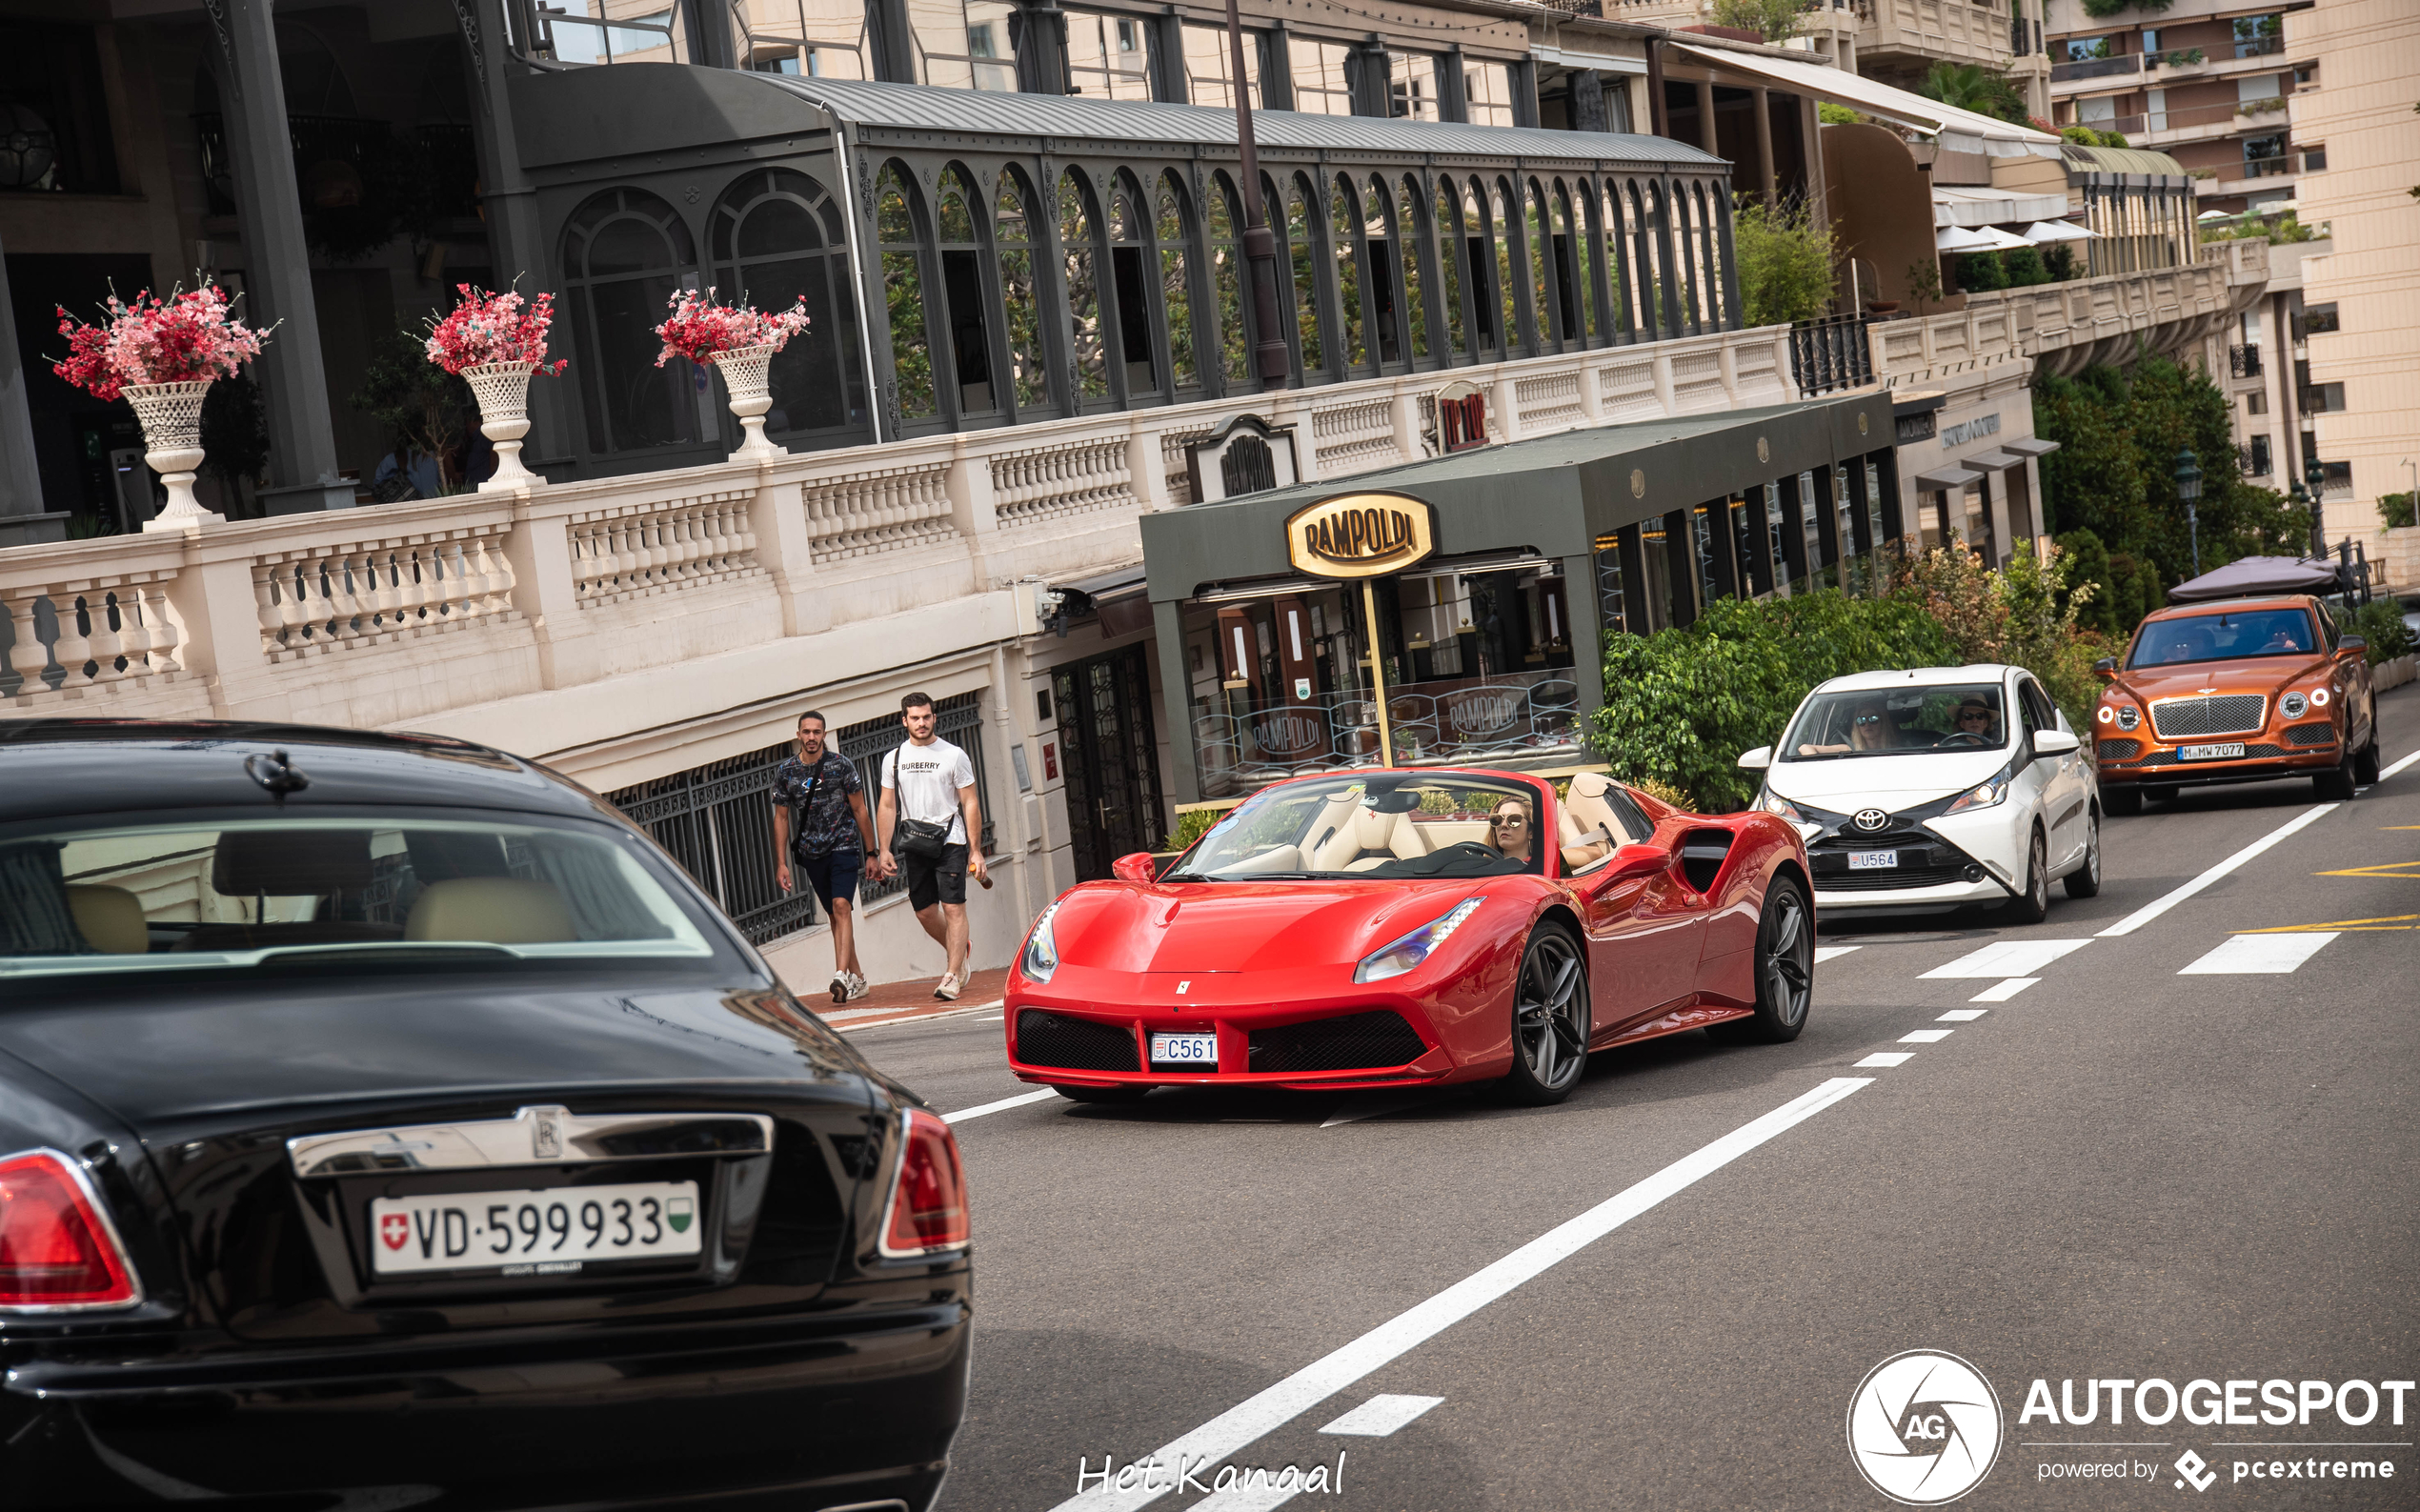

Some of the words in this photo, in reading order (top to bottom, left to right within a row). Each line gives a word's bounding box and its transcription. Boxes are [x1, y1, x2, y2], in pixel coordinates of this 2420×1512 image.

[1442, 398, 1461, 445] TIP
[1463, 393, 1485, 441] TOP
[1305, 508, 1413, 562] RAMPOLDI
[1450, 696, 1518, 735] RAMPOLDI
[1253, 716, 1320, 754] RAMPOLDI
[1861, 854, 1894, 866] U564
[1168, 1039, 1214, 1058] C561
